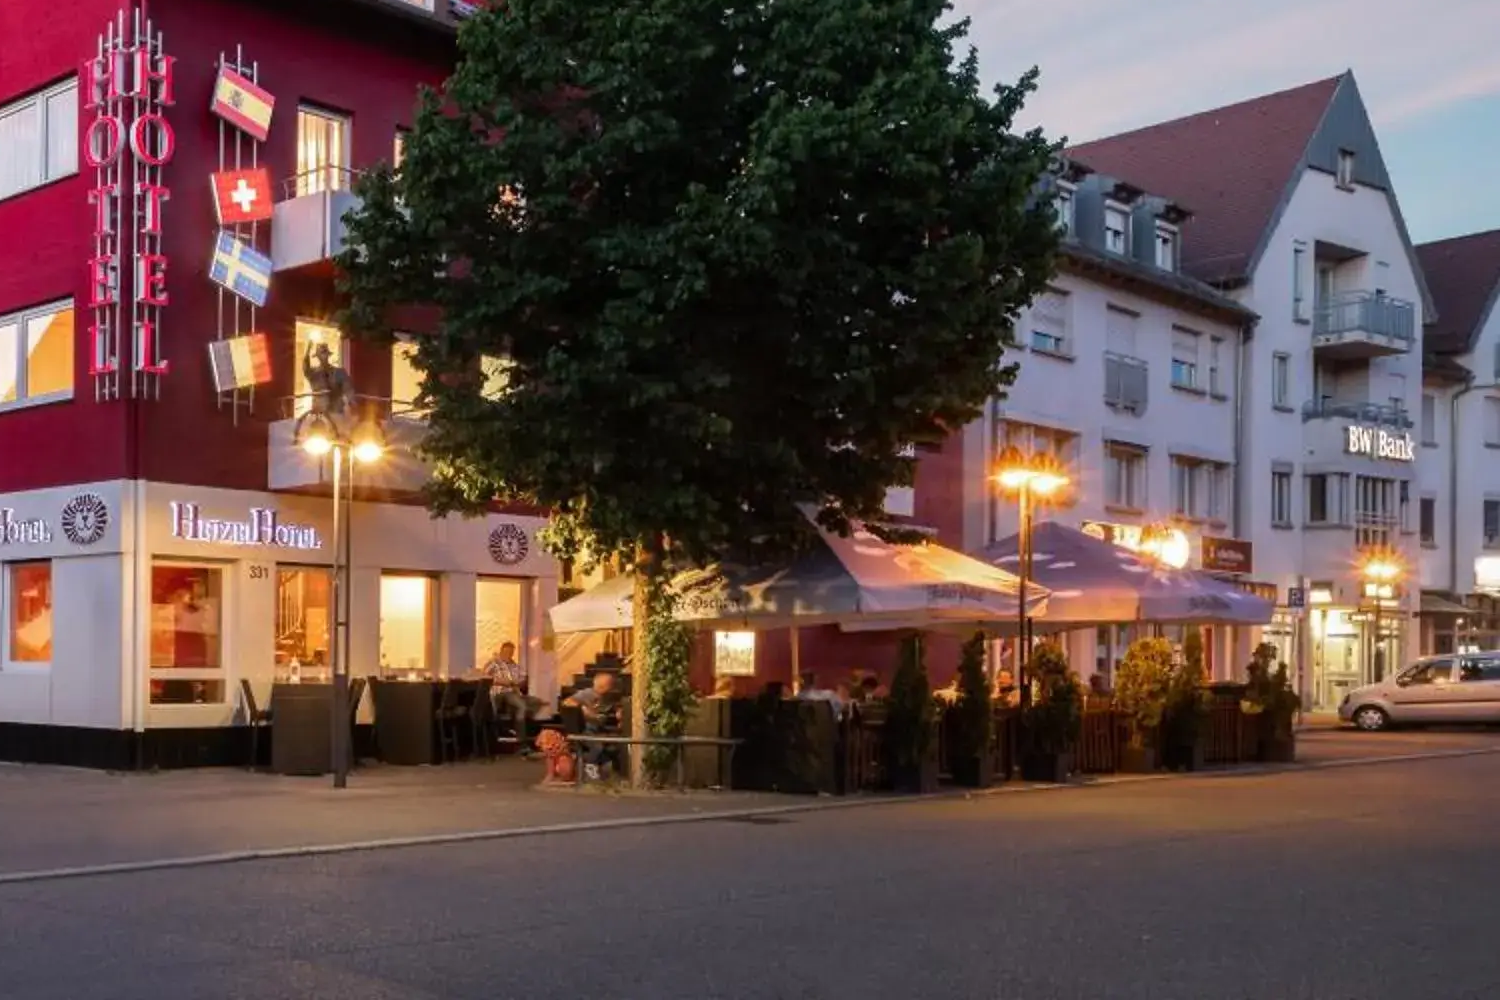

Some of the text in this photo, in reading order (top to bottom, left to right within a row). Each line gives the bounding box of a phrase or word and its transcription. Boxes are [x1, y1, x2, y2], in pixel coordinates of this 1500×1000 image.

[84, 48, 125, 374] HOTEL
[130, 48, 177, 374] HOTEL
[1377, 429, 1415, 461] Bank
[250, 564, 269, 580] 331
